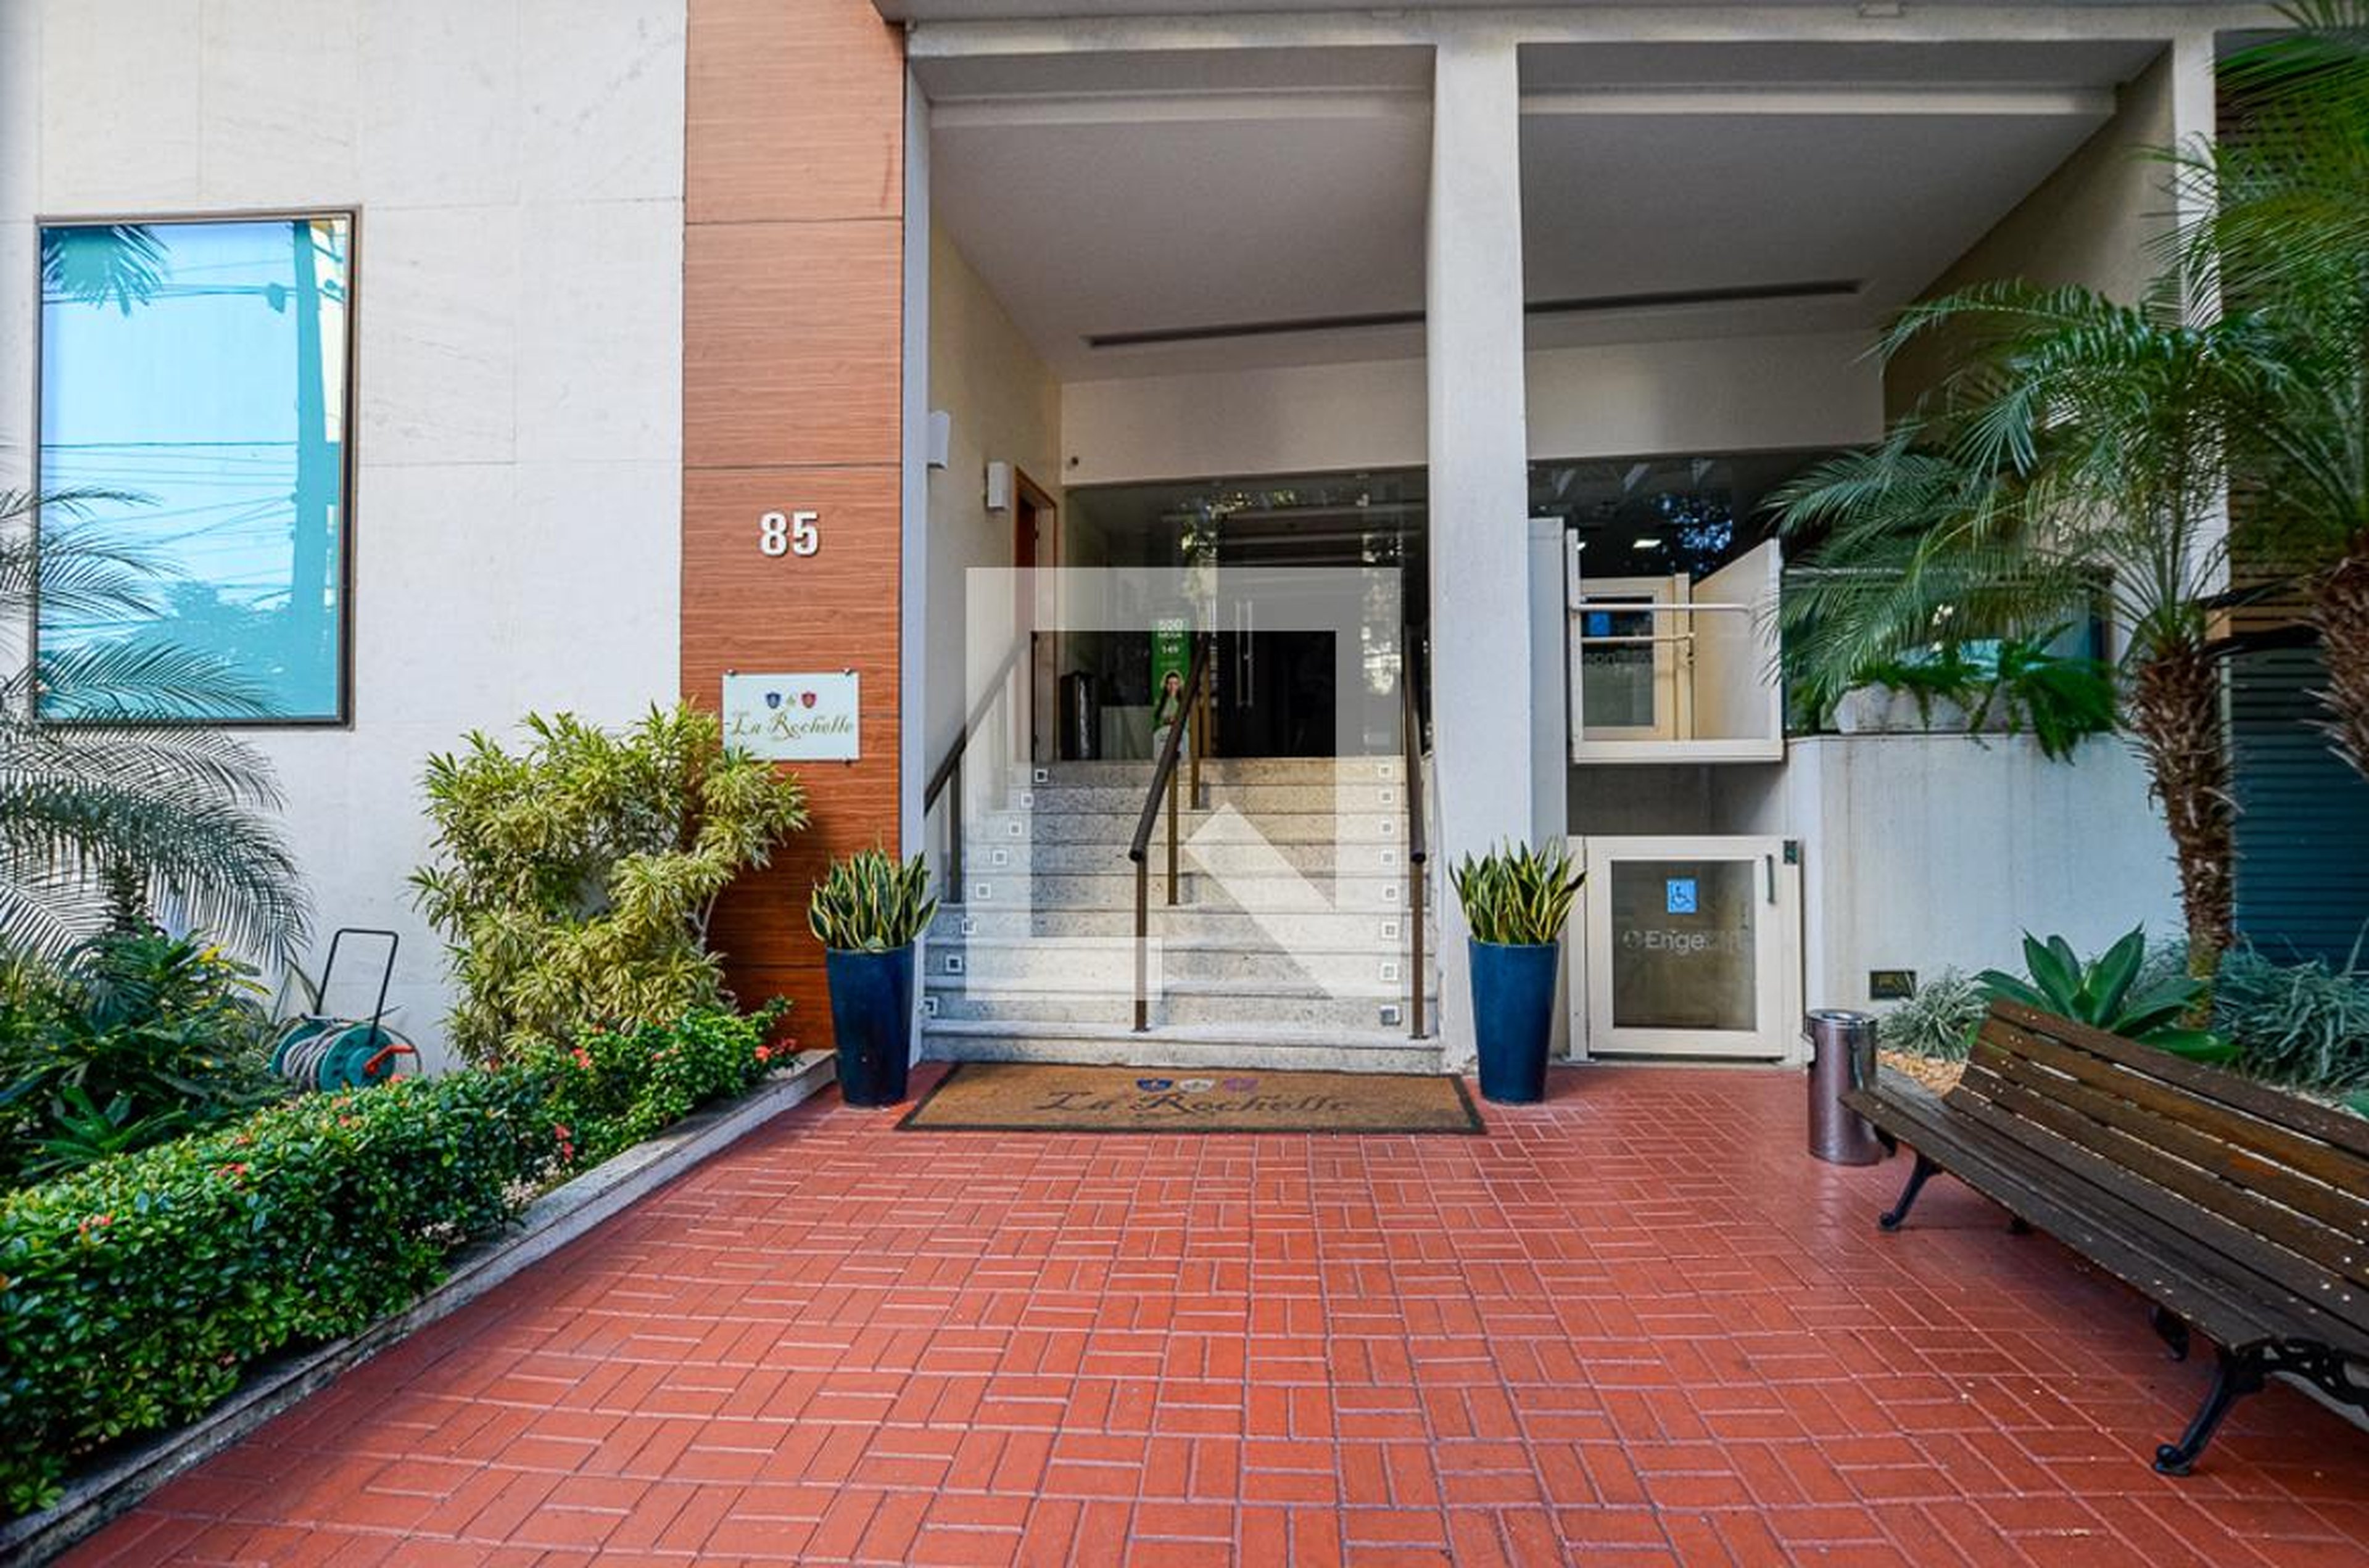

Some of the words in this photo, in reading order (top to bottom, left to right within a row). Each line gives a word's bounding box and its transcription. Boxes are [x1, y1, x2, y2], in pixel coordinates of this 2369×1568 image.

[759, 511, 818, 556] 85
[732, 711, 762, 736] La
[767, 710, 853, 741] Rochelle
[1037, 1091, 1114, 1111] La
[1131, 1089, 1353, 1118] Rochelle
